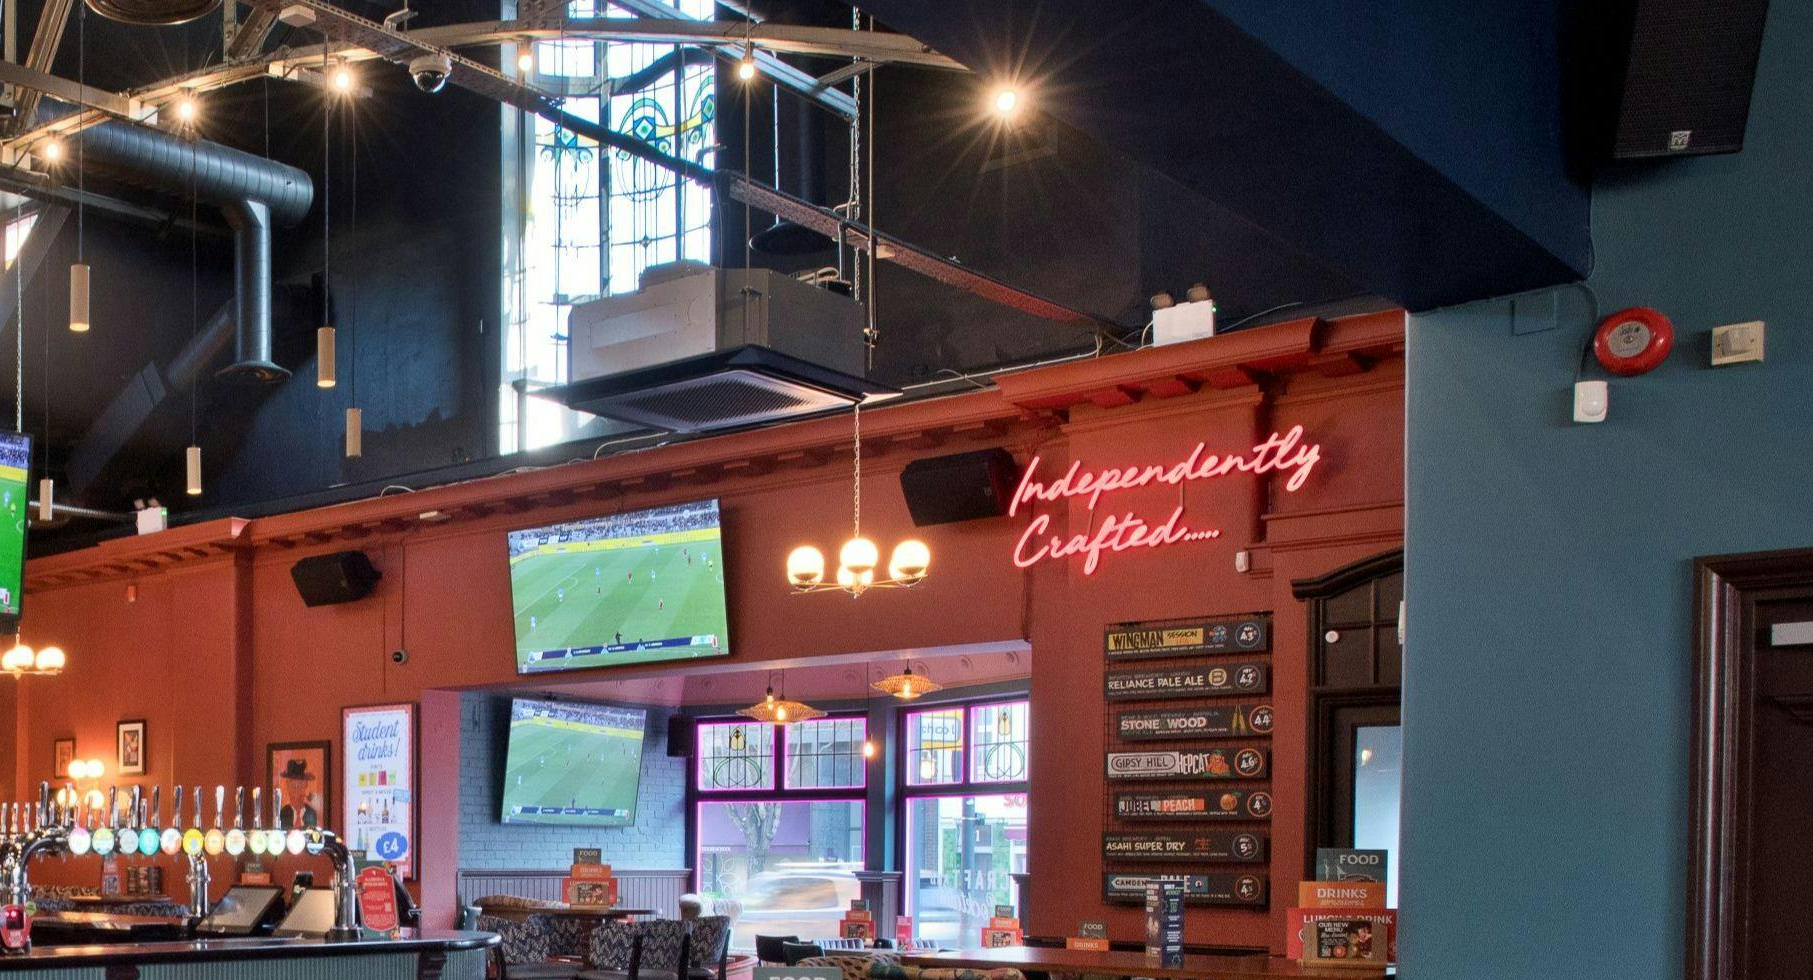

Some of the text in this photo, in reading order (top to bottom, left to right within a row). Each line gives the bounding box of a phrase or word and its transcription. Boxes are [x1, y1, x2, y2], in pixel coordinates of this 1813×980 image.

[1009, 424, 1320, 517] Independently
[1112, 631, 1164, 649] WINGMAN
[1108, 675, 1204, 690] RELIANCE PALE ALE
[1120, 719, 1160, 730] STONE
[1166, 716, 1207, 729] WOOD
[352, 720, 400, 743] Student
[358, 737, 401, 761] drinks!
[1115, 756, 1142, 768] GIPSY
[1146, 756, 1169, 767] HILL
[1177, 753, 1210, 775] HEPCAT
[1163, 799, 1195, 812] PEACH
[382, 837, 400, 851] £4
[1106, 841, 1186, 851] ASAHI SUPER DRY
[1339, 854, 1379, 865] FOOD
[1317, 888, 1367, 899] DRINKS
